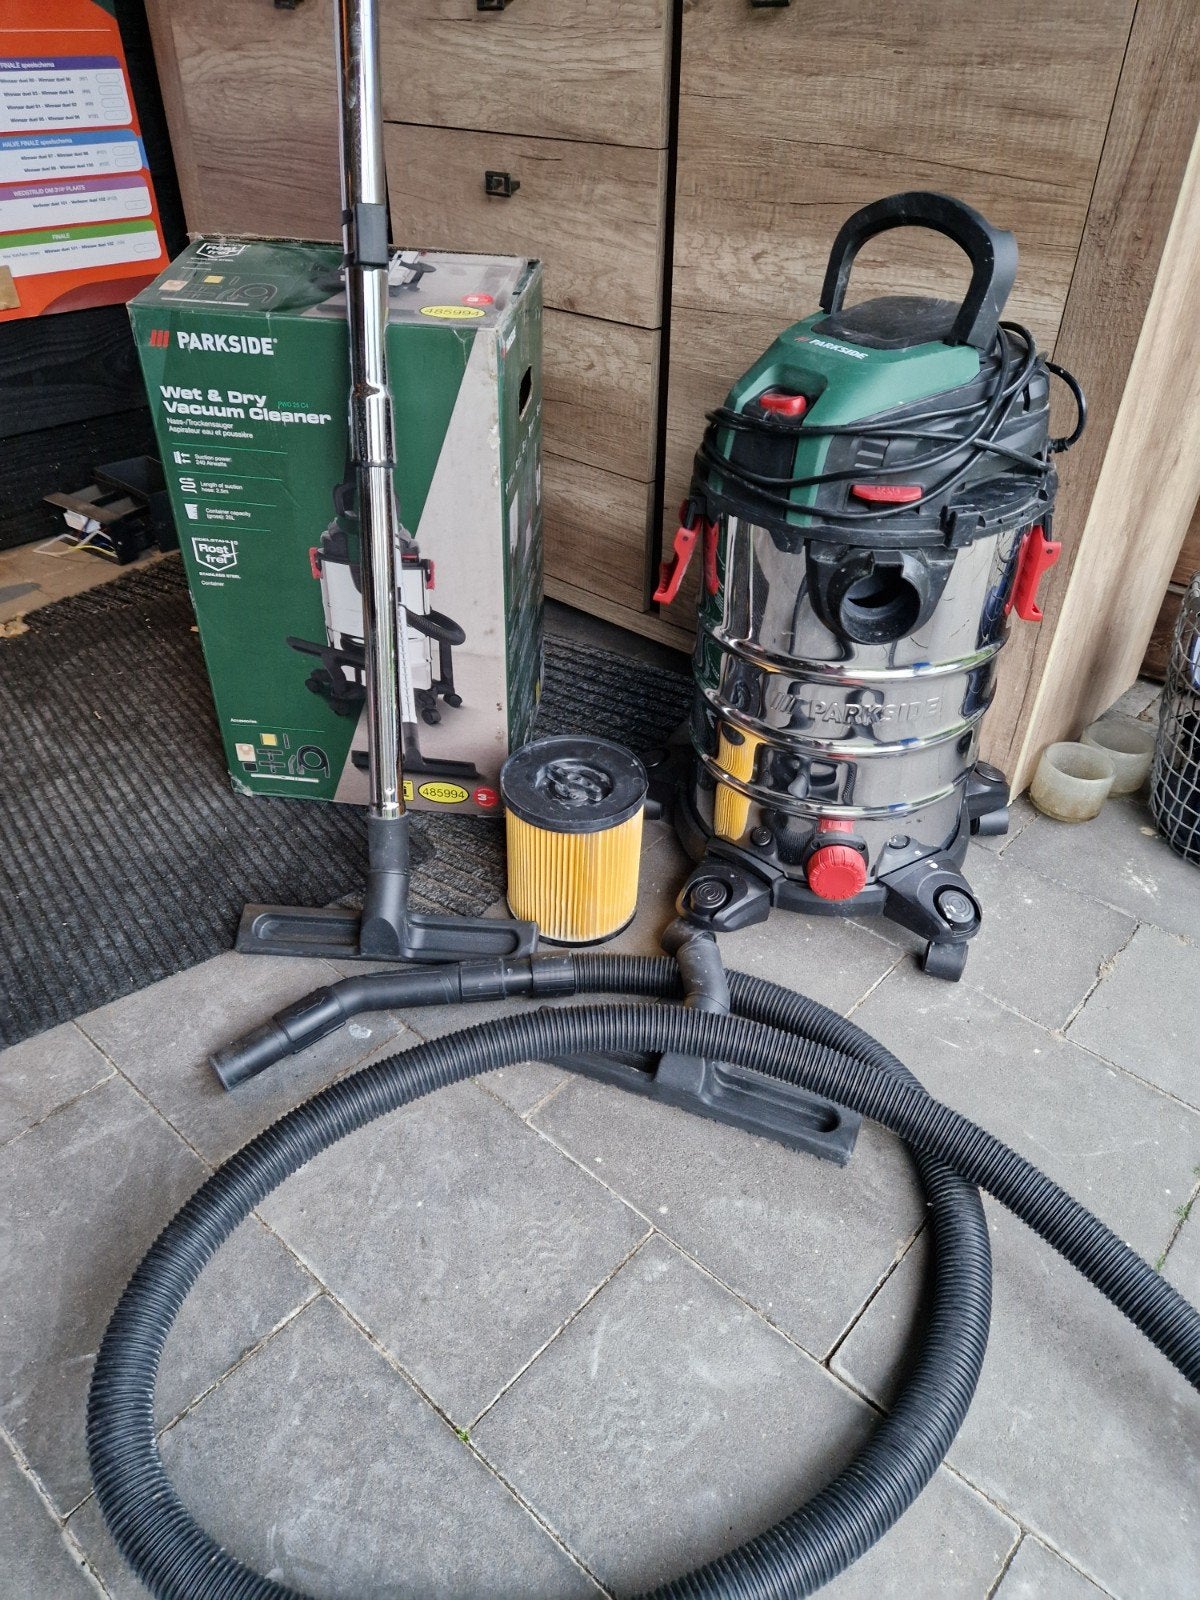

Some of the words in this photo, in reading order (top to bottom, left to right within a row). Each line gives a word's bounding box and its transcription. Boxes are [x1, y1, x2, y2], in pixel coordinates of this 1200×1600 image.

[425, 308, 480, 317] 485994
[176, 331, 275, 356] PARKSIDE
[809, 339, 869, 360] PARKSIDE
[159, 385, 203, 401] Wet
[207, 389, 223, 403] &
[227, 390, 267, 408] Dry
[163, 400, 245, 419] Vacuum
[250, 407, 332, 425] Cleaner
[168, 425, 201, 436] Aspirateur
[201, 428, 214, 436] eau
[222, 429, 254, 439] poussière
[200, 481, 218, 489] Length
[230, 510, 251, 518] capacity
[198, 543, 229, 554] Rost
[205, 554, 228, 564] frei
[809, 697, 942, 725] PARKSIDE
[422, 787, 466, 799] 485994
